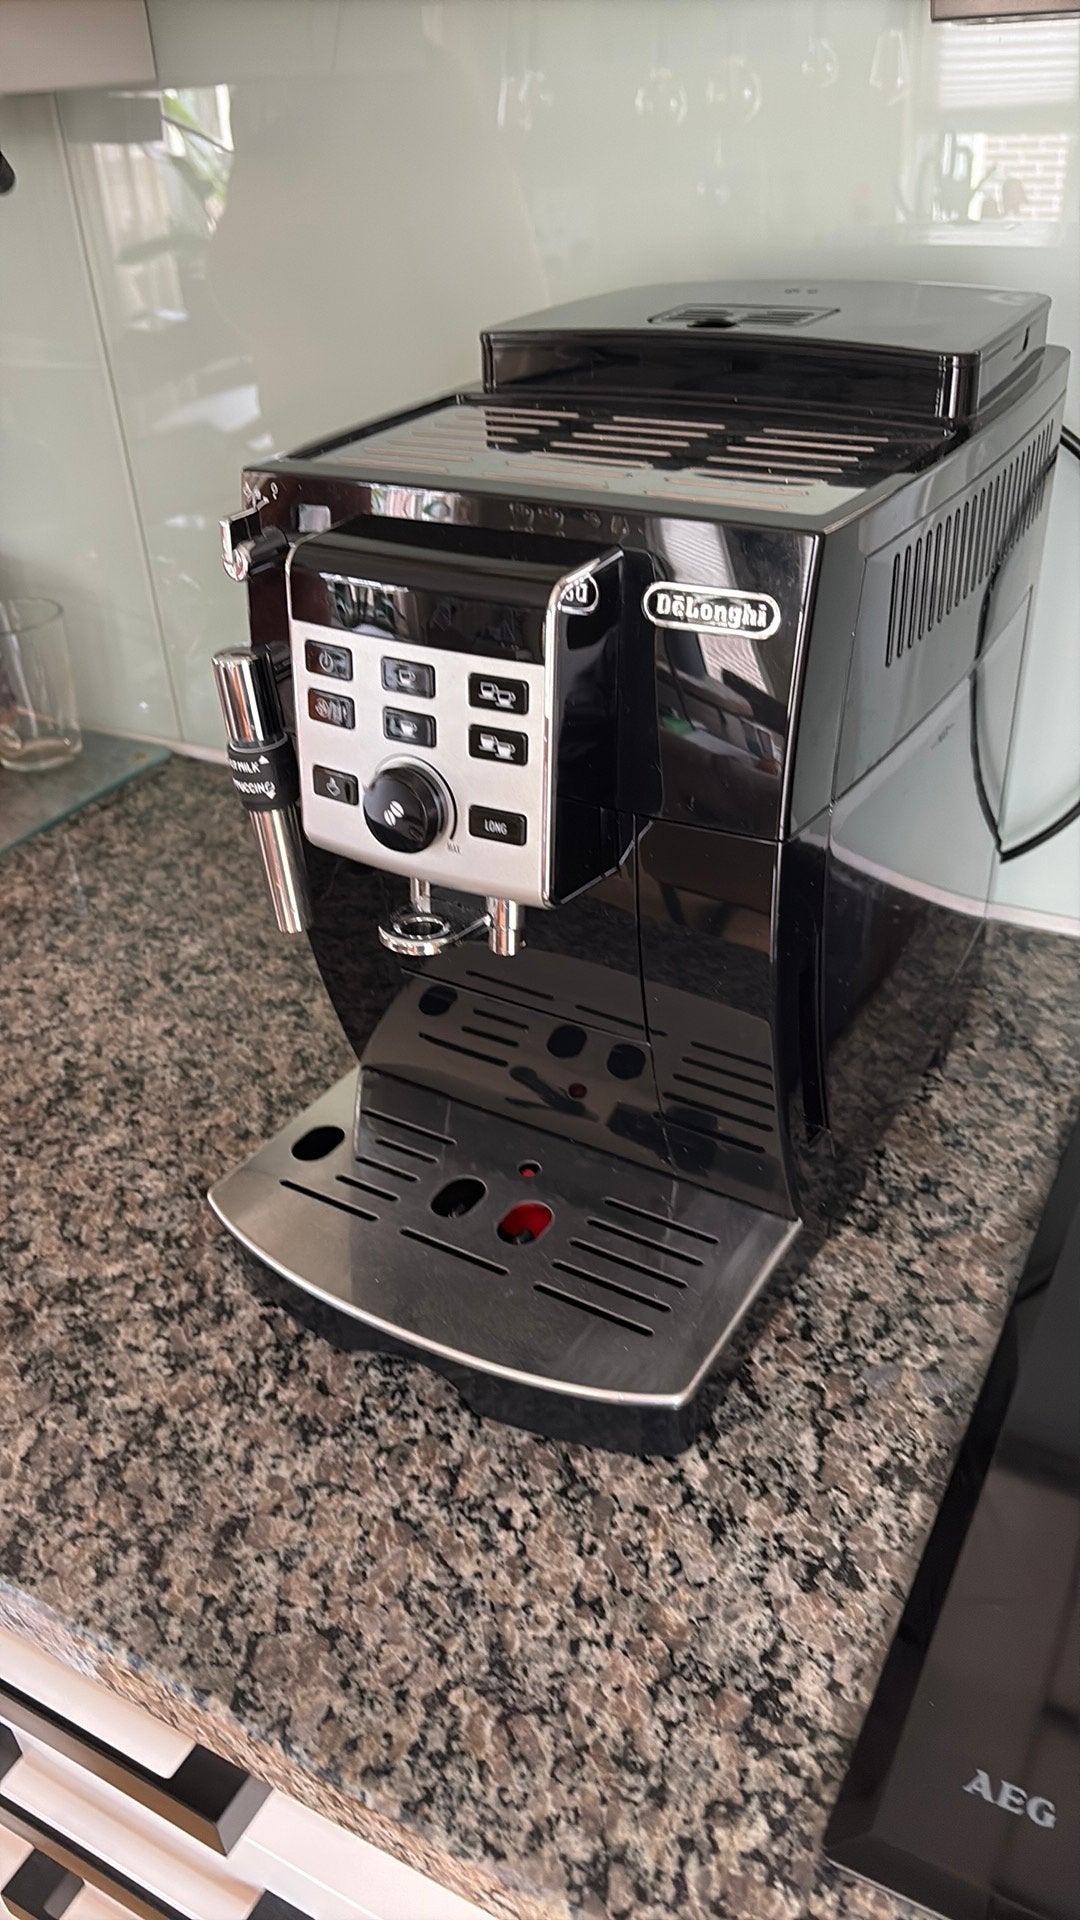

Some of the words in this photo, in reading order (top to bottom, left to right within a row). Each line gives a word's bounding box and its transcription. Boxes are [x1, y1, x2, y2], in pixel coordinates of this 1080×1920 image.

[237, 761, 261, 773] MILK
[484, 818, 508, 835] LONG
[962, 1768, 1056, 1829] AEG
